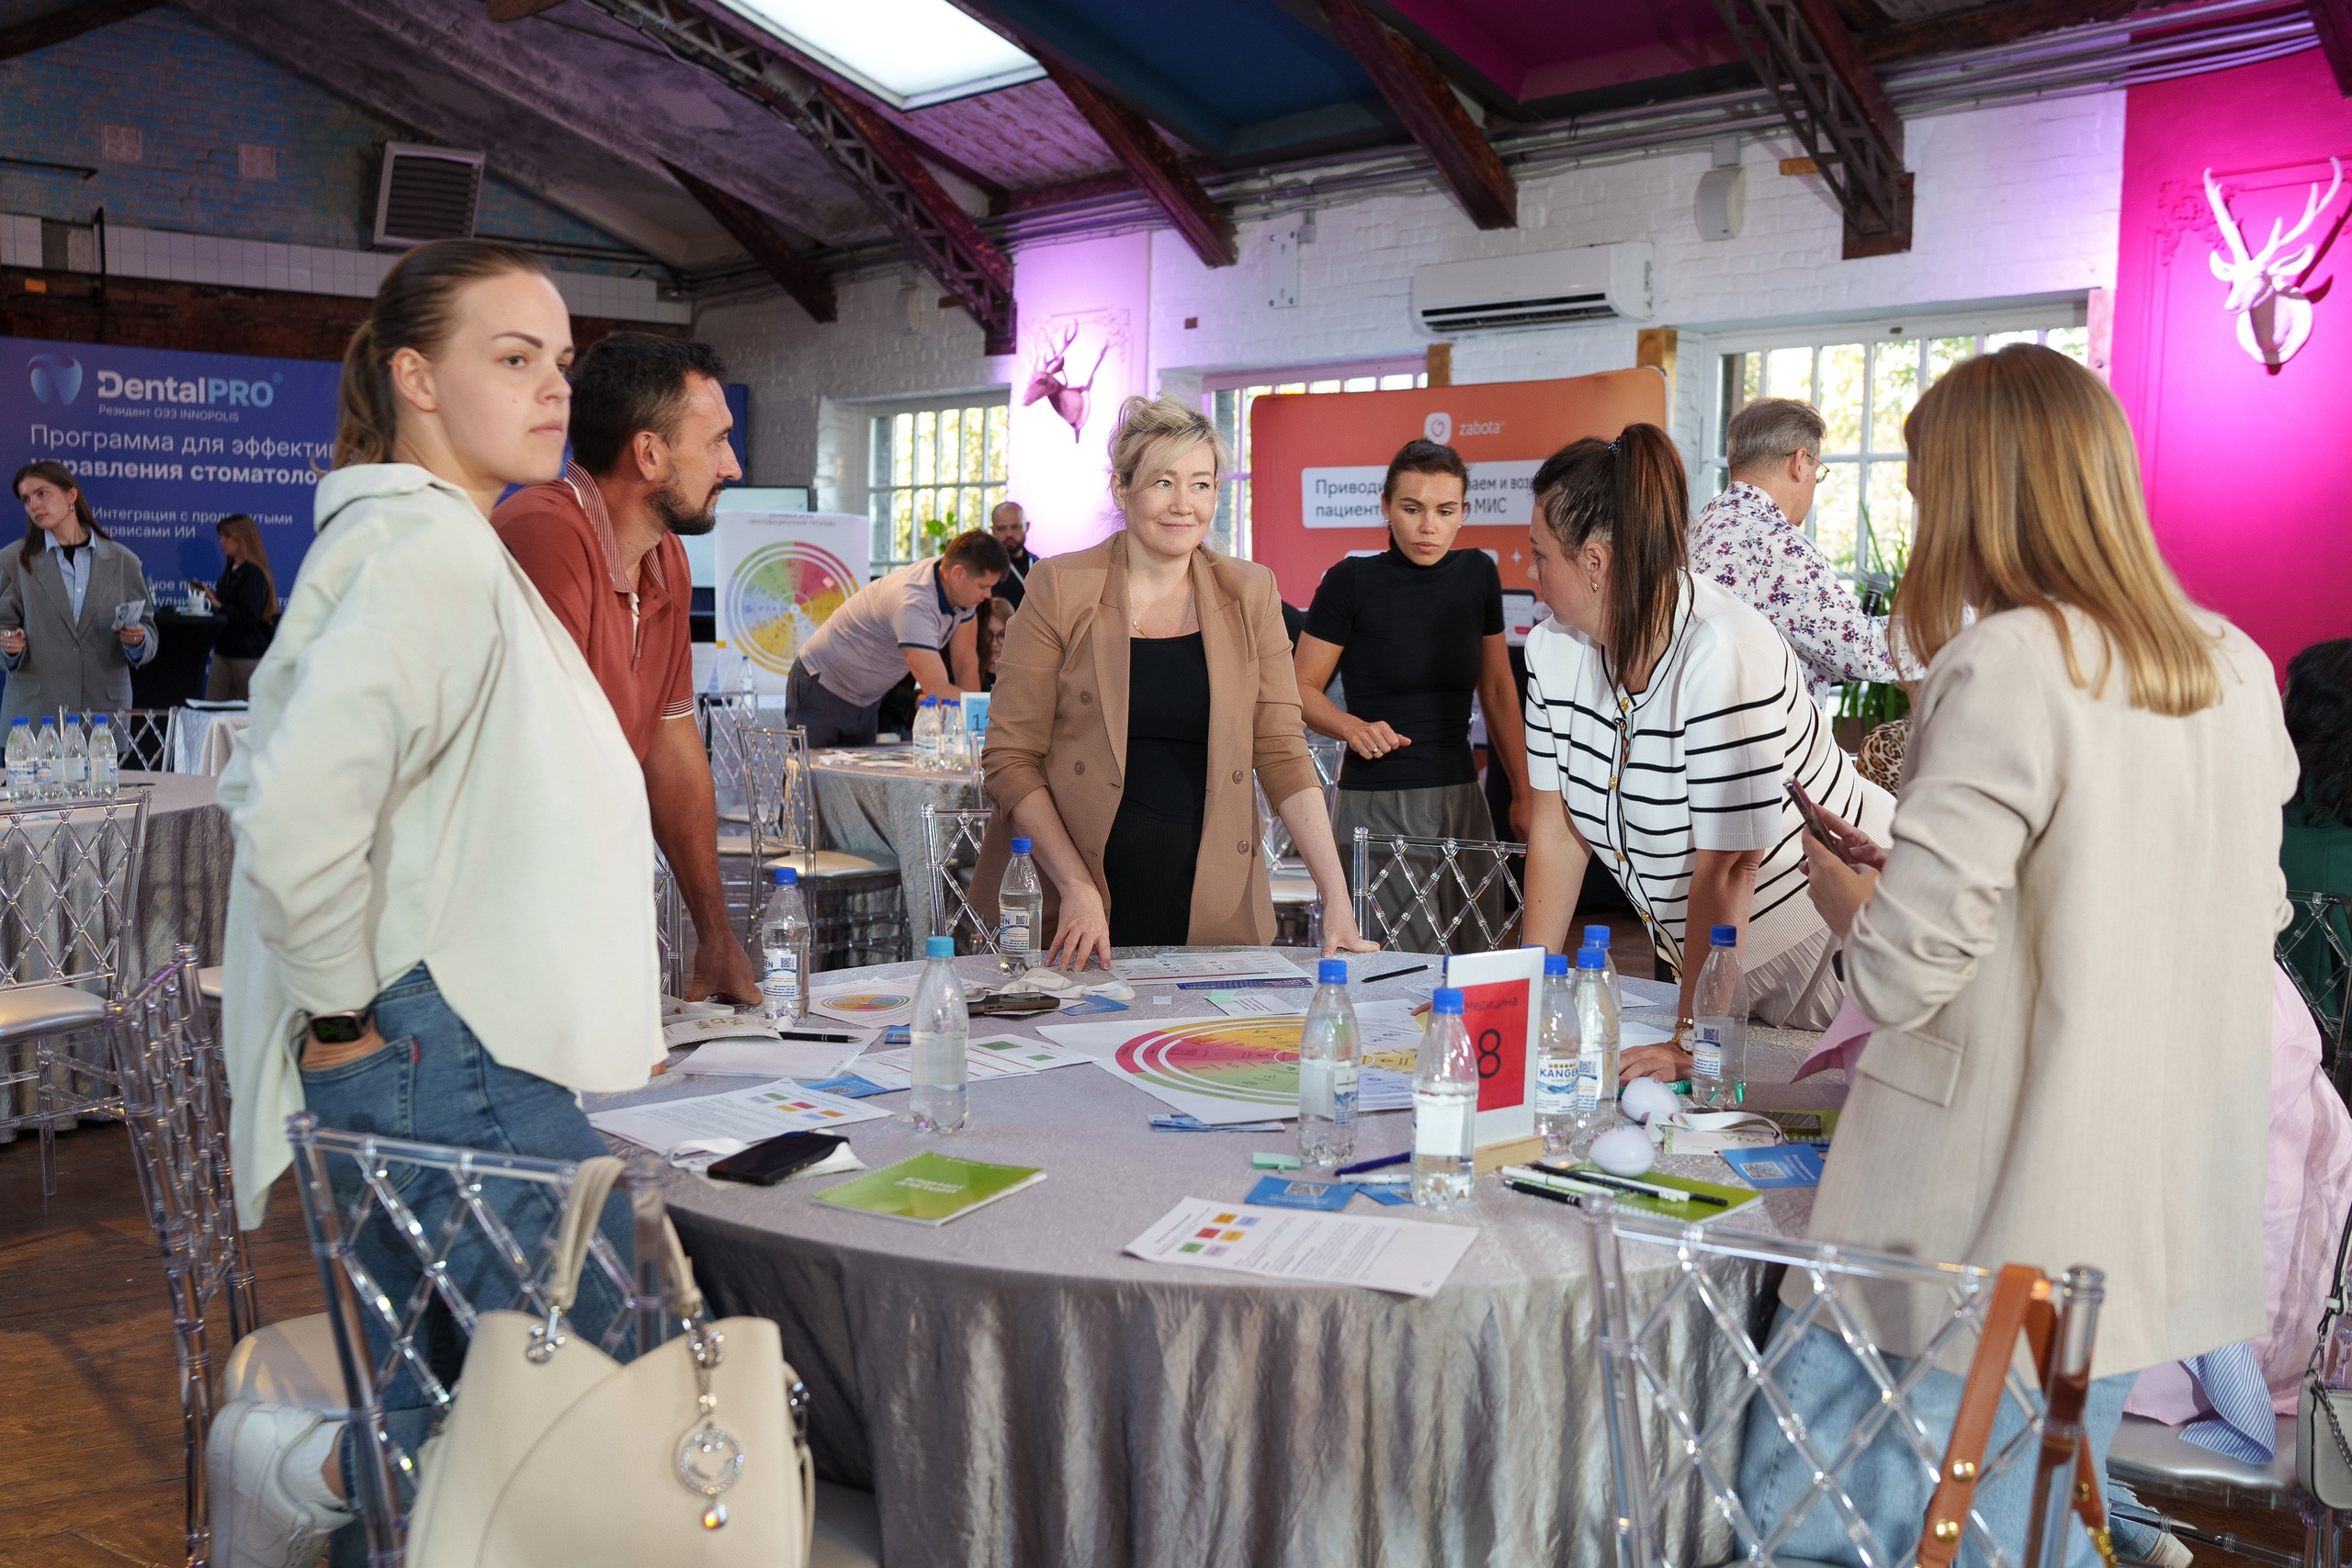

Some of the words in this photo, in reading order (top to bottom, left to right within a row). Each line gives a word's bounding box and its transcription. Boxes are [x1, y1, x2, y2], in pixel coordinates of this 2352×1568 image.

[97, 369, 274, 408] DentalPRO
[98, 403, 151, 419] Резидент
[180, 408, 239, 423] INNOPOLIS
[1459, 420, 1500, 435] zabota
[30, 423, 174, 453] Программа
[181, 436, 224, 457] для
[190, 464, 318, 486] стоматоло
[1316, 479, 1385, 499] Приводи
[1499, 478, 1508, 490] и
[92, 506, 176, 523] Интеграция
[180, 510, 188, 519] с
[1316, 504, 1380, 520] пациент
[1475, 497, 1507, 514] МИС
[101, 525, 171, 538] ервисами
[175, 525, 196, 538] ИИ
[1477, 1029, 1501, 1079] 8
